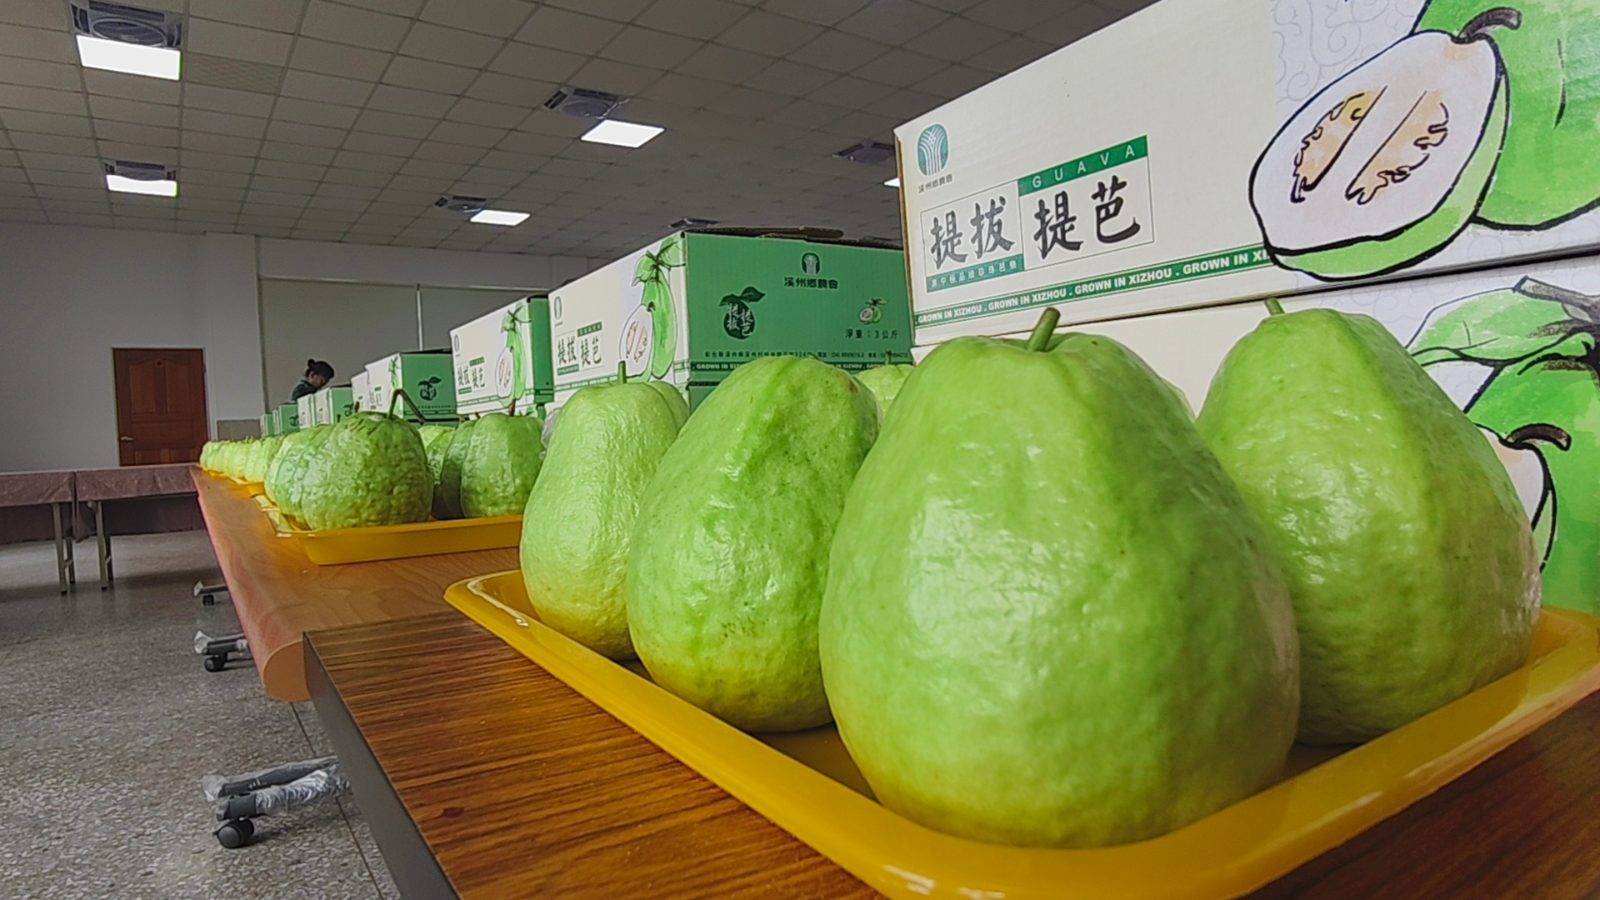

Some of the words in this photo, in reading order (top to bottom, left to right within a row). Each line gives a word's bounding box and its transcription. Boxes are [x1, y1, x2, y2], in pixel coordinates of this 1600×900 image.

[1031, 143, 1136, 189] GUAVA
[930, 195, 1016, 270] 提拔
[1033, 174, 1141, 260] 提芭
[918, 311, 943, 324] GROWN
[944, 310, 953, 320] IN
[953, 304, 982, 317] XIZHOU
[988, 297, 1018, 311] GROWN
[1020, 295, 1030, 305] IN
[1032, 287, 1067, 303] XIZHOU
[1074, 279, 1112, 295] GROWN
[1114, 277, 1126, 288] IN
[1128, 268, 1172, 285] XIZHOU
[1182, 256, 1230, 275] GROWN
[1233, 253, 1249, 265] IN
[1252, 249, 1270, 262] XI
